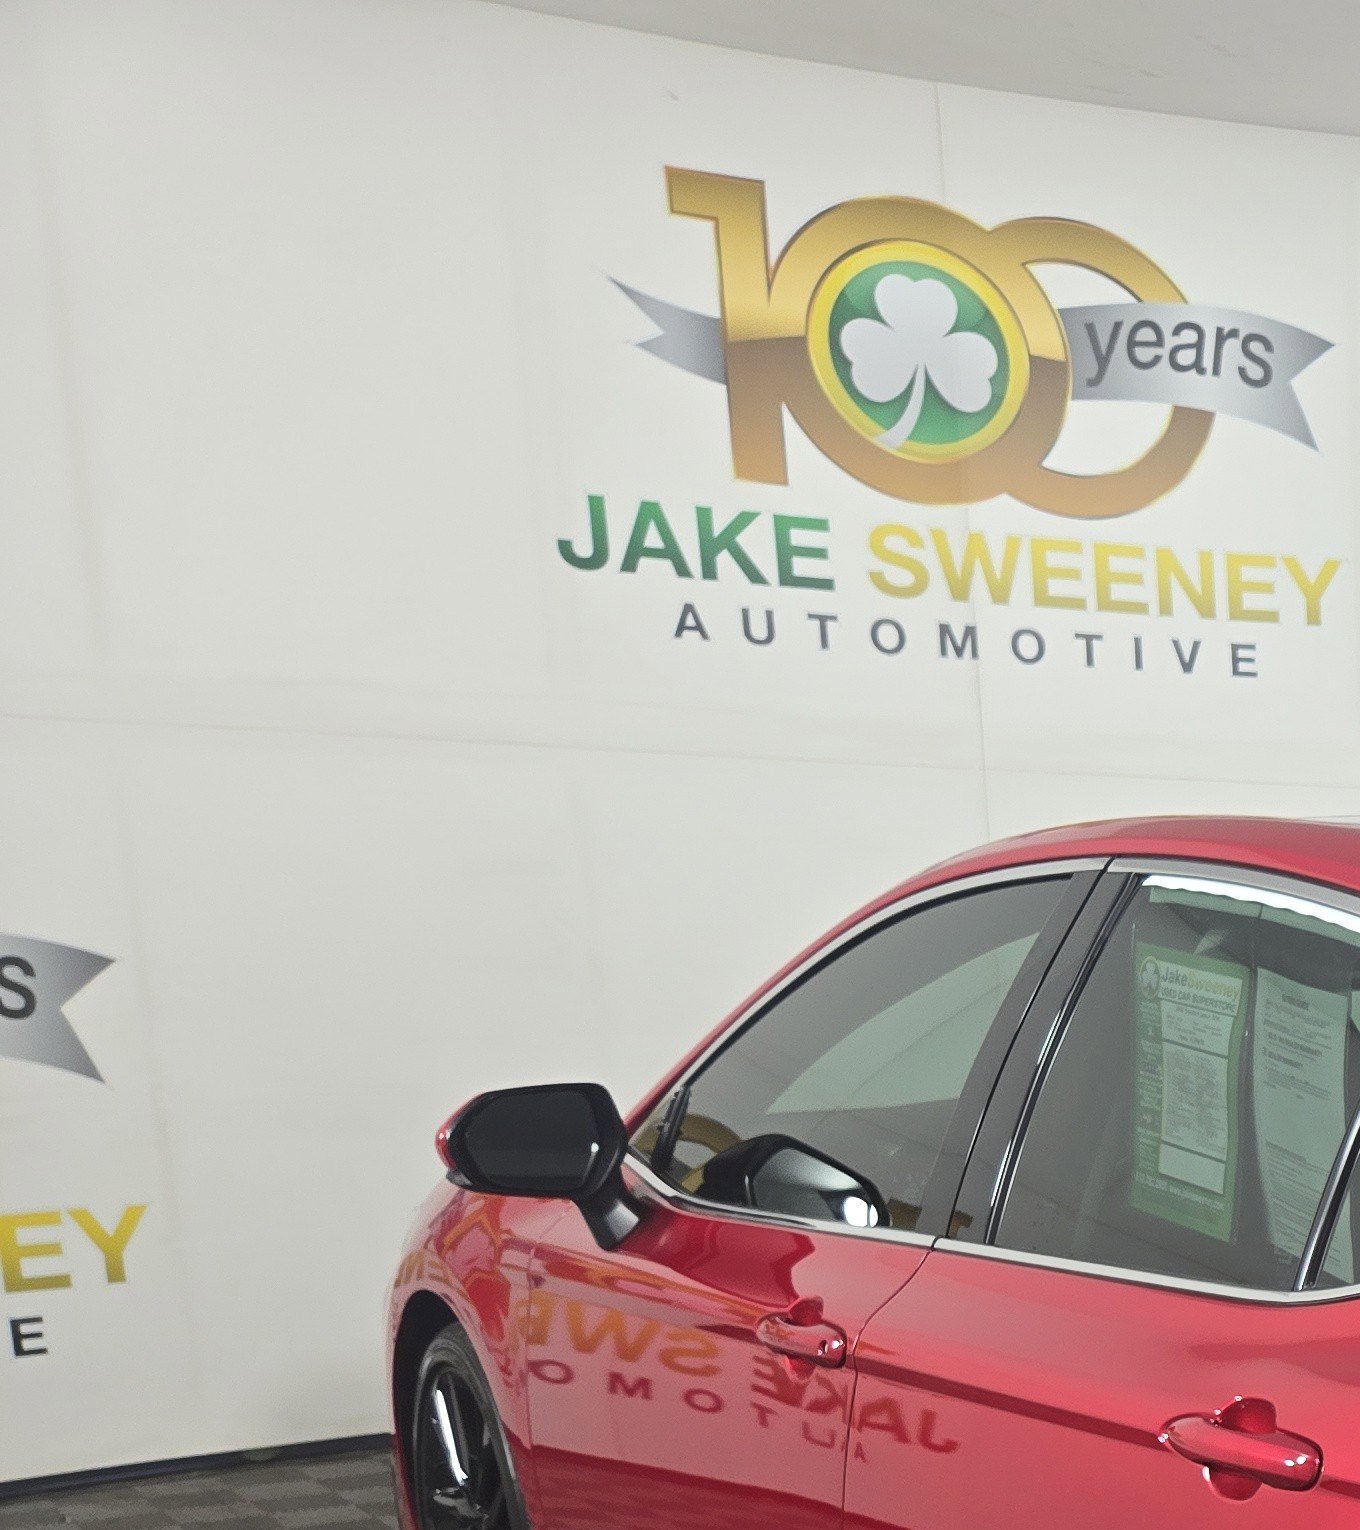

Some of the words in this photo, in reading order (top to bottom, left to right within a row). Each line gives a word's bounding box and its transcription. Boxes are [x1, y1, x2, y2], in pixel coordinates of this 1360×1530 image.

[664, 165, 1216, 520] 100
[1084, 316, 1275, 389] years
[557, 494, 836, 592] JAKE
[867, 522, 1342, 626] SWEENEY
[673, 601, 1260, 678] AUTOMOTIVE
